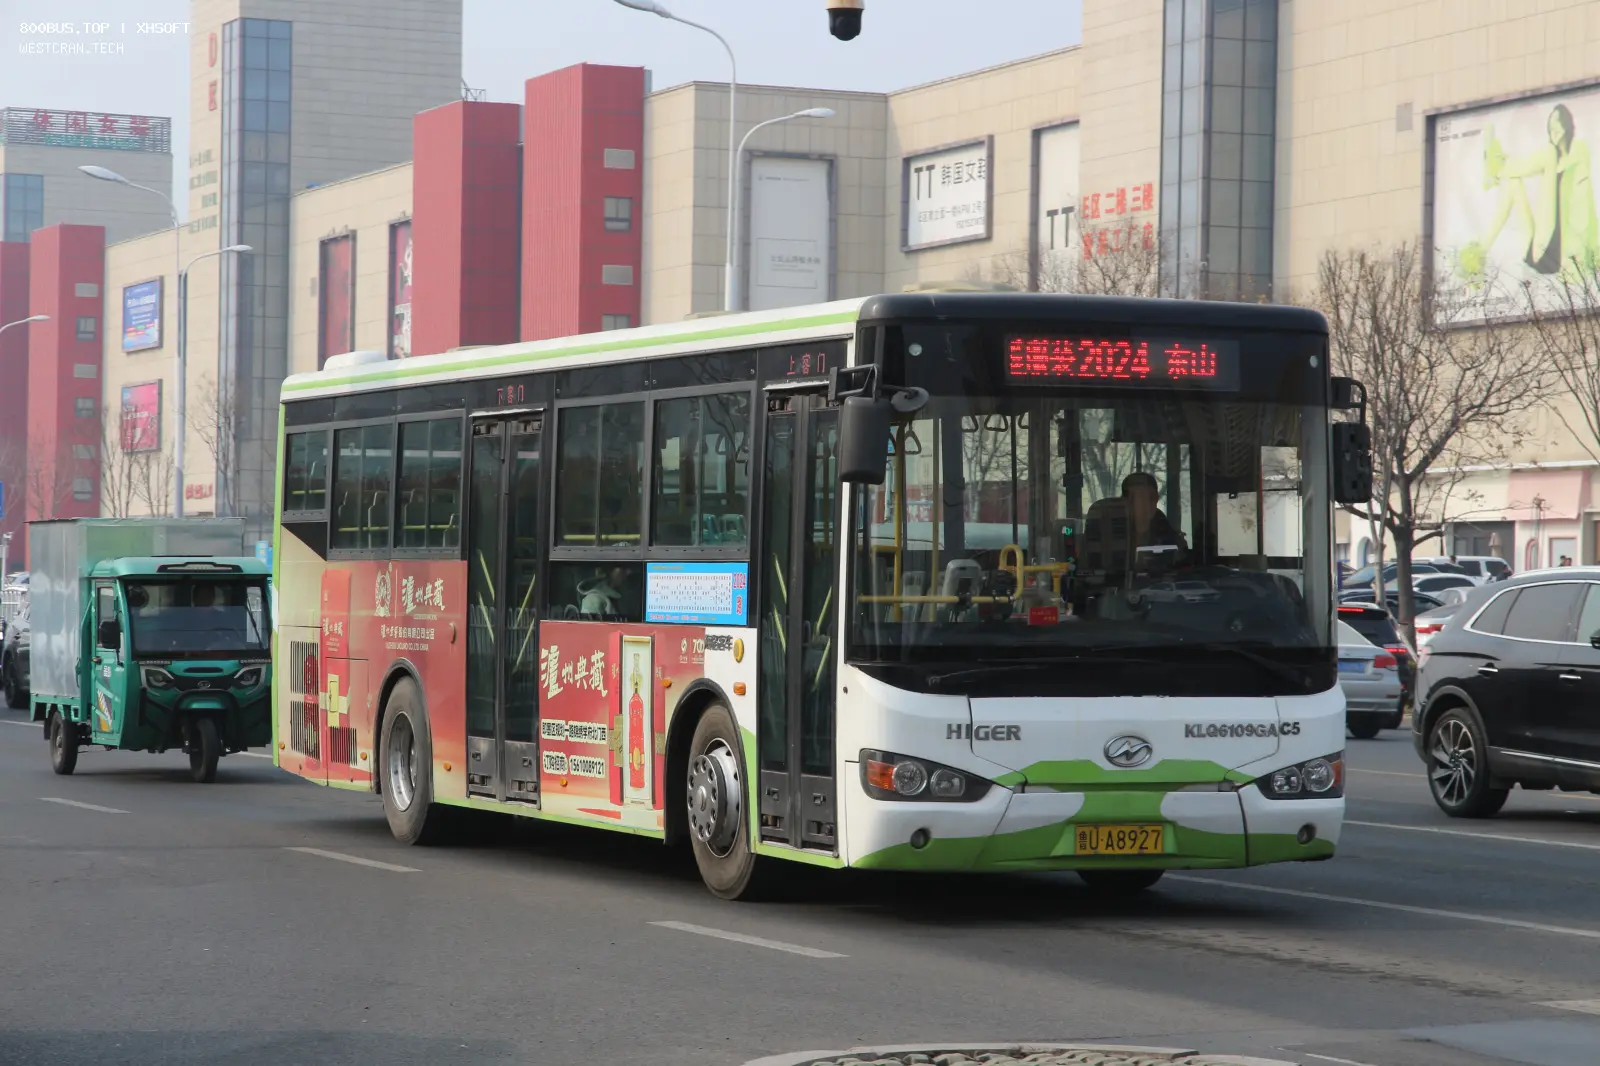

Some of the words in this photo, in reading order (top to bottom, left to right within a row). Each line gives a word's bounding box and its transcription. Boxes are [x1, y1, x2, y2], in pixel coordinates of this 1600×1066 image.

[914, 164, 936, 200] TT
[1046, 205, 1075, 250] TT
[787, 352, 826, 375] 上客门
[497, 384, 525, 405] 下客门
[946, 723, 1022, 741] HIGER
[1184, 721, 1301, 739] KLQ6109GAC5
